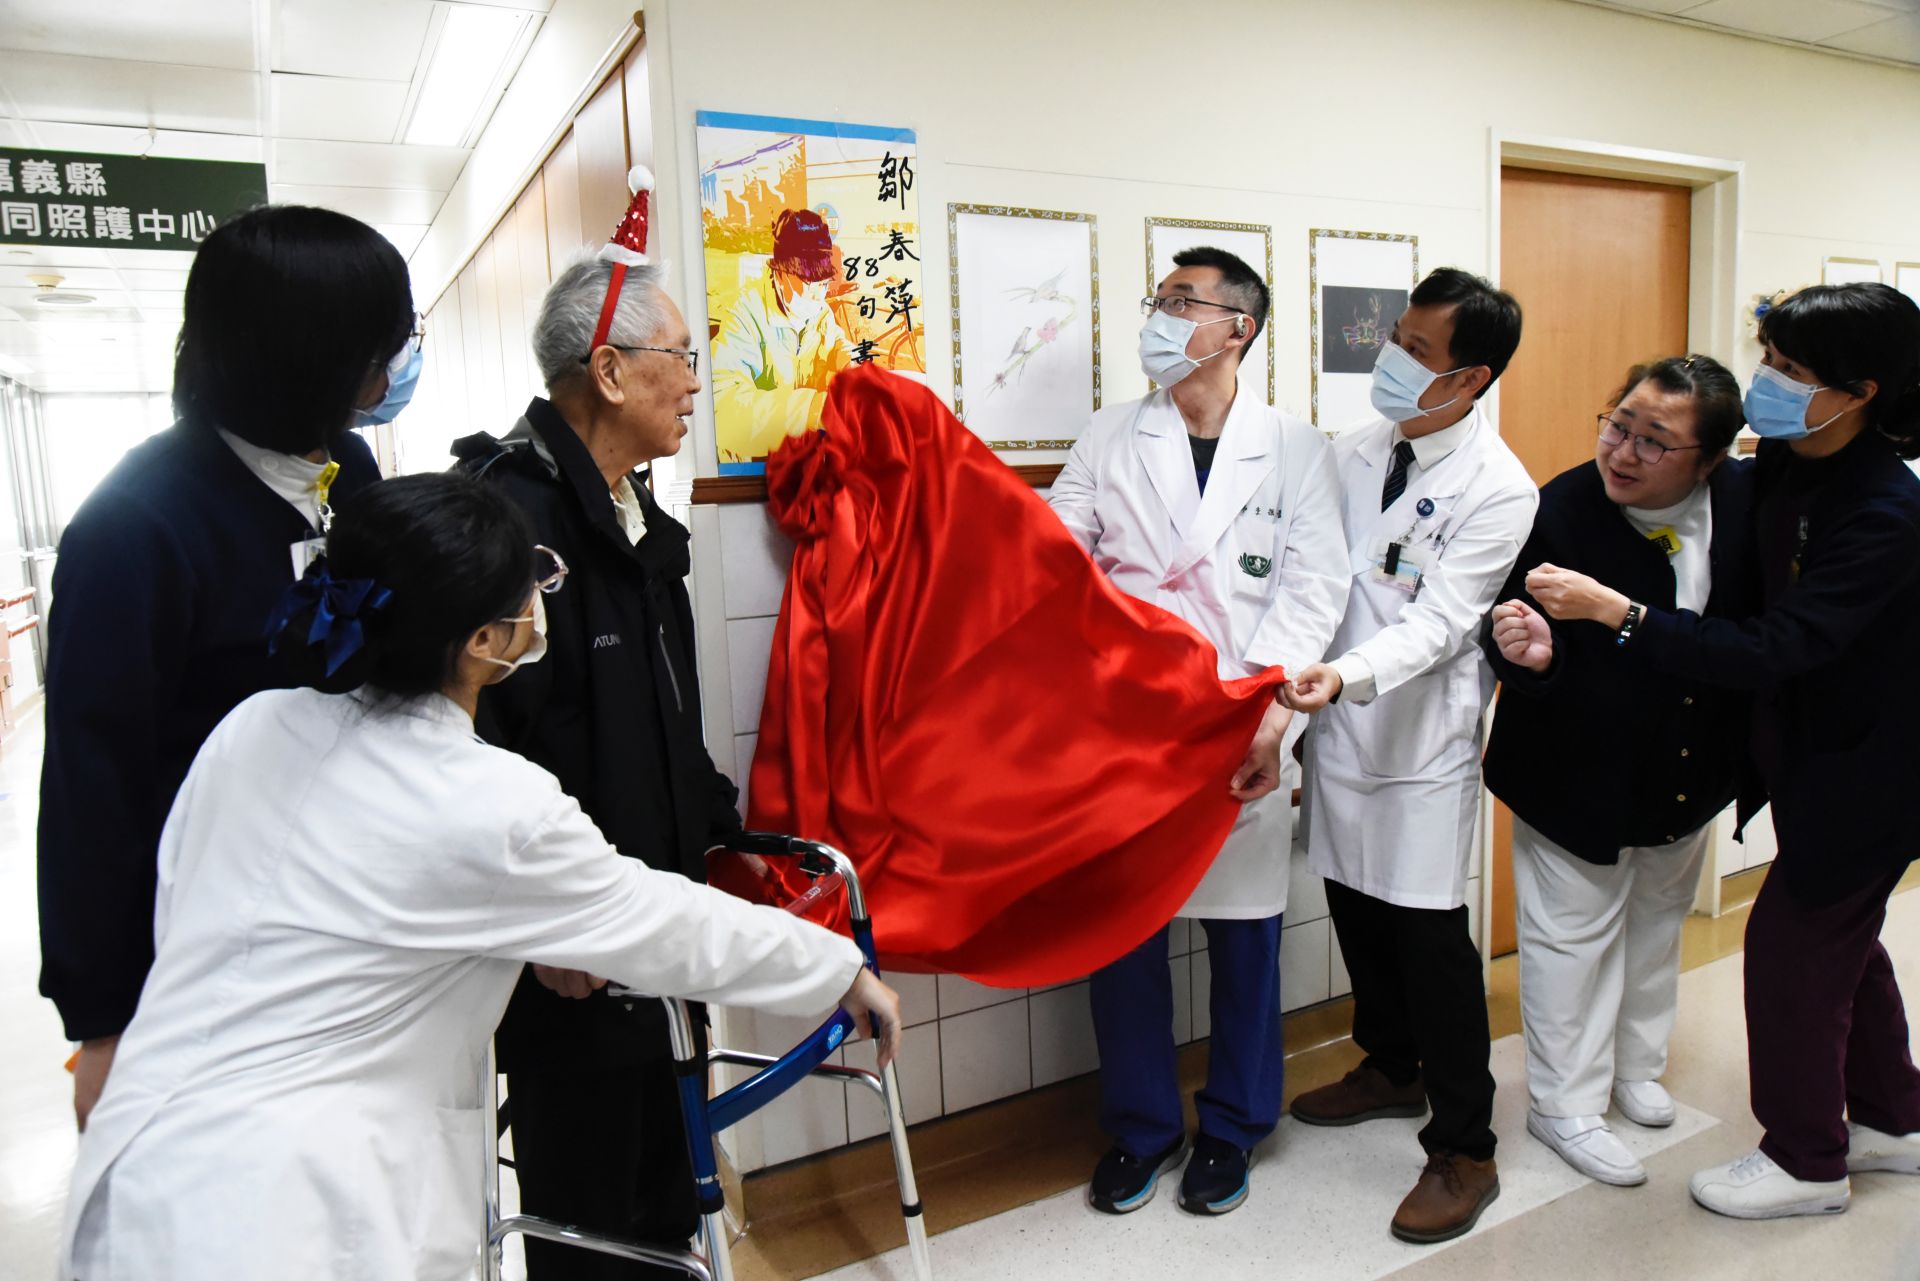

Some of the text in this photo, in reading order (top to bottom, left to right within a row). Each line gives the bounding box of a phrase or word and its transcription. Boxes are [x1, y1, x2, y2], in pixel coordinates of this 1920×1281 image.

[1, 201, 217, 243] 同照護中心
